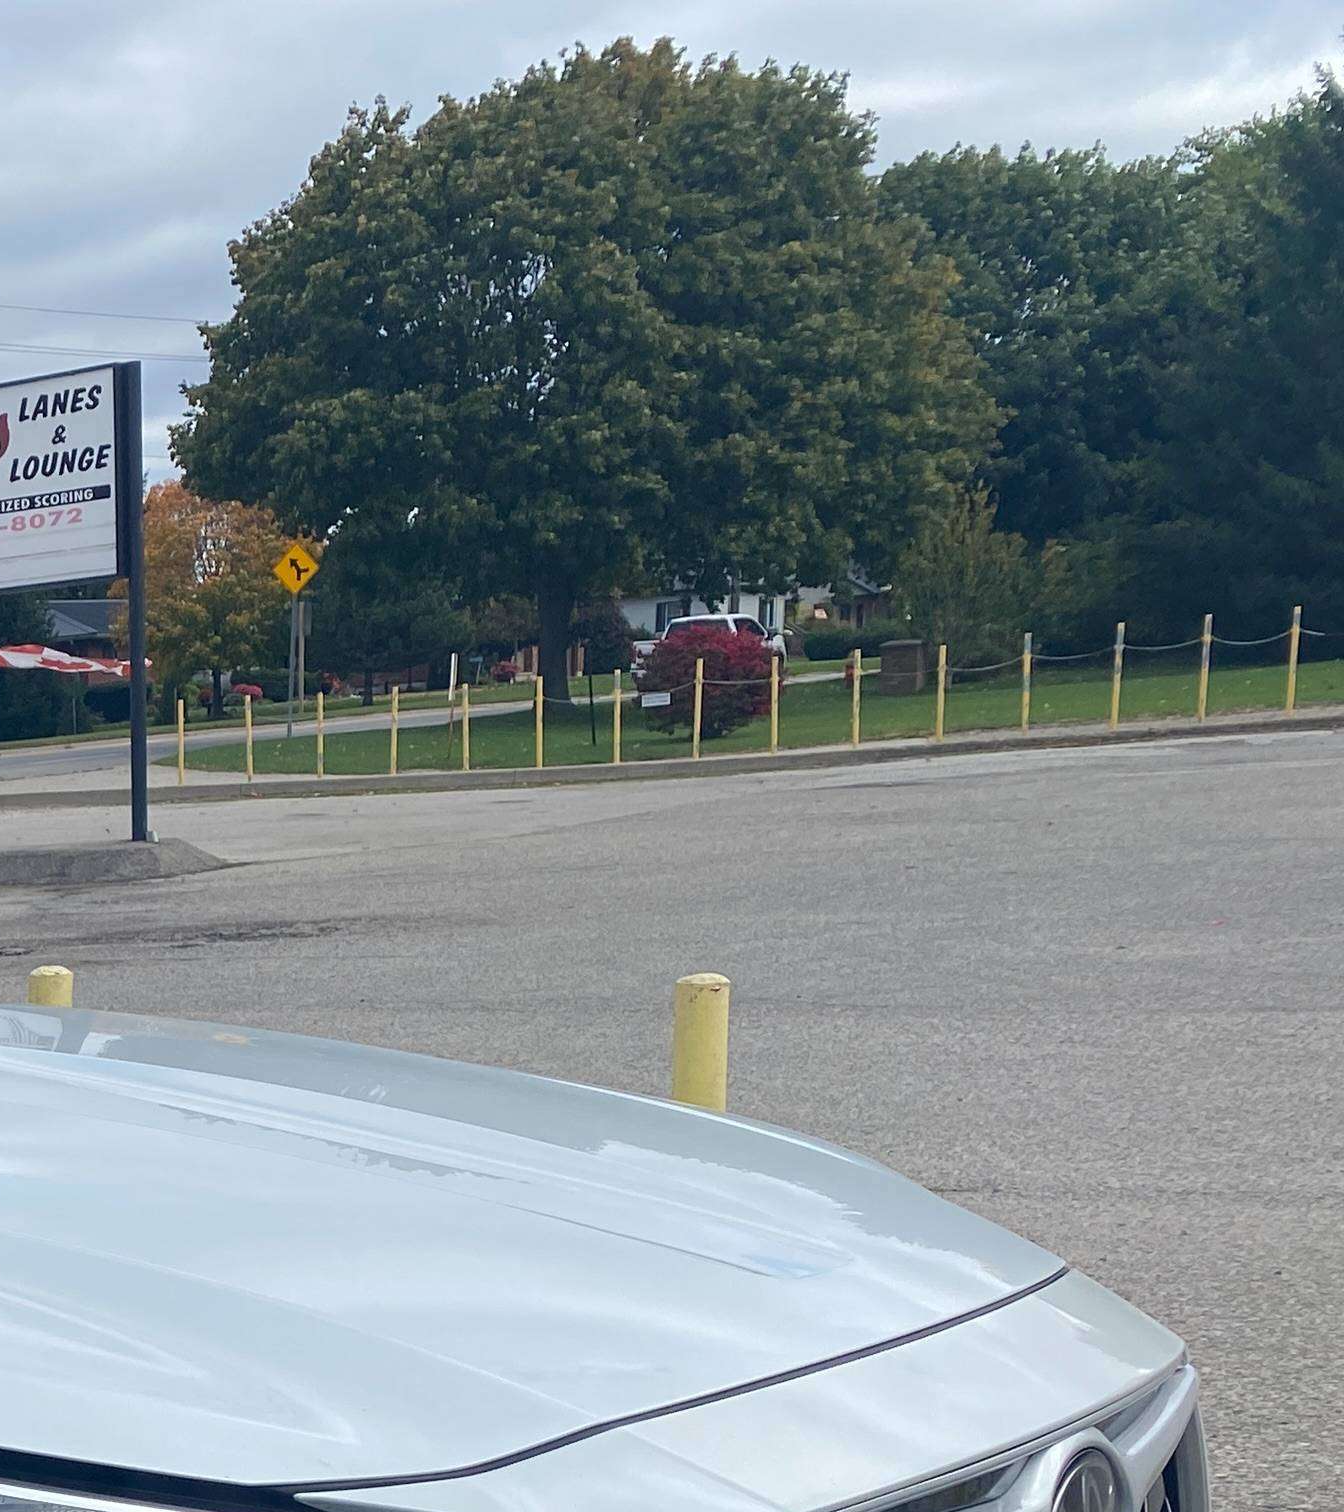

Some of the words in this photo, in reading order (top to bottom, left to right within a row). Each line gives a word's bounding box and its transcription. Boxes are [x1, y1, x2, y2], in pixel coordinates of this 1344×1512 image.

[18, 384, 102, 422] LANES
[51, 424, 67, 445] &
[9, 444, 112, 483] LOUNGE
[34, 488, 94, 508] SCORING
